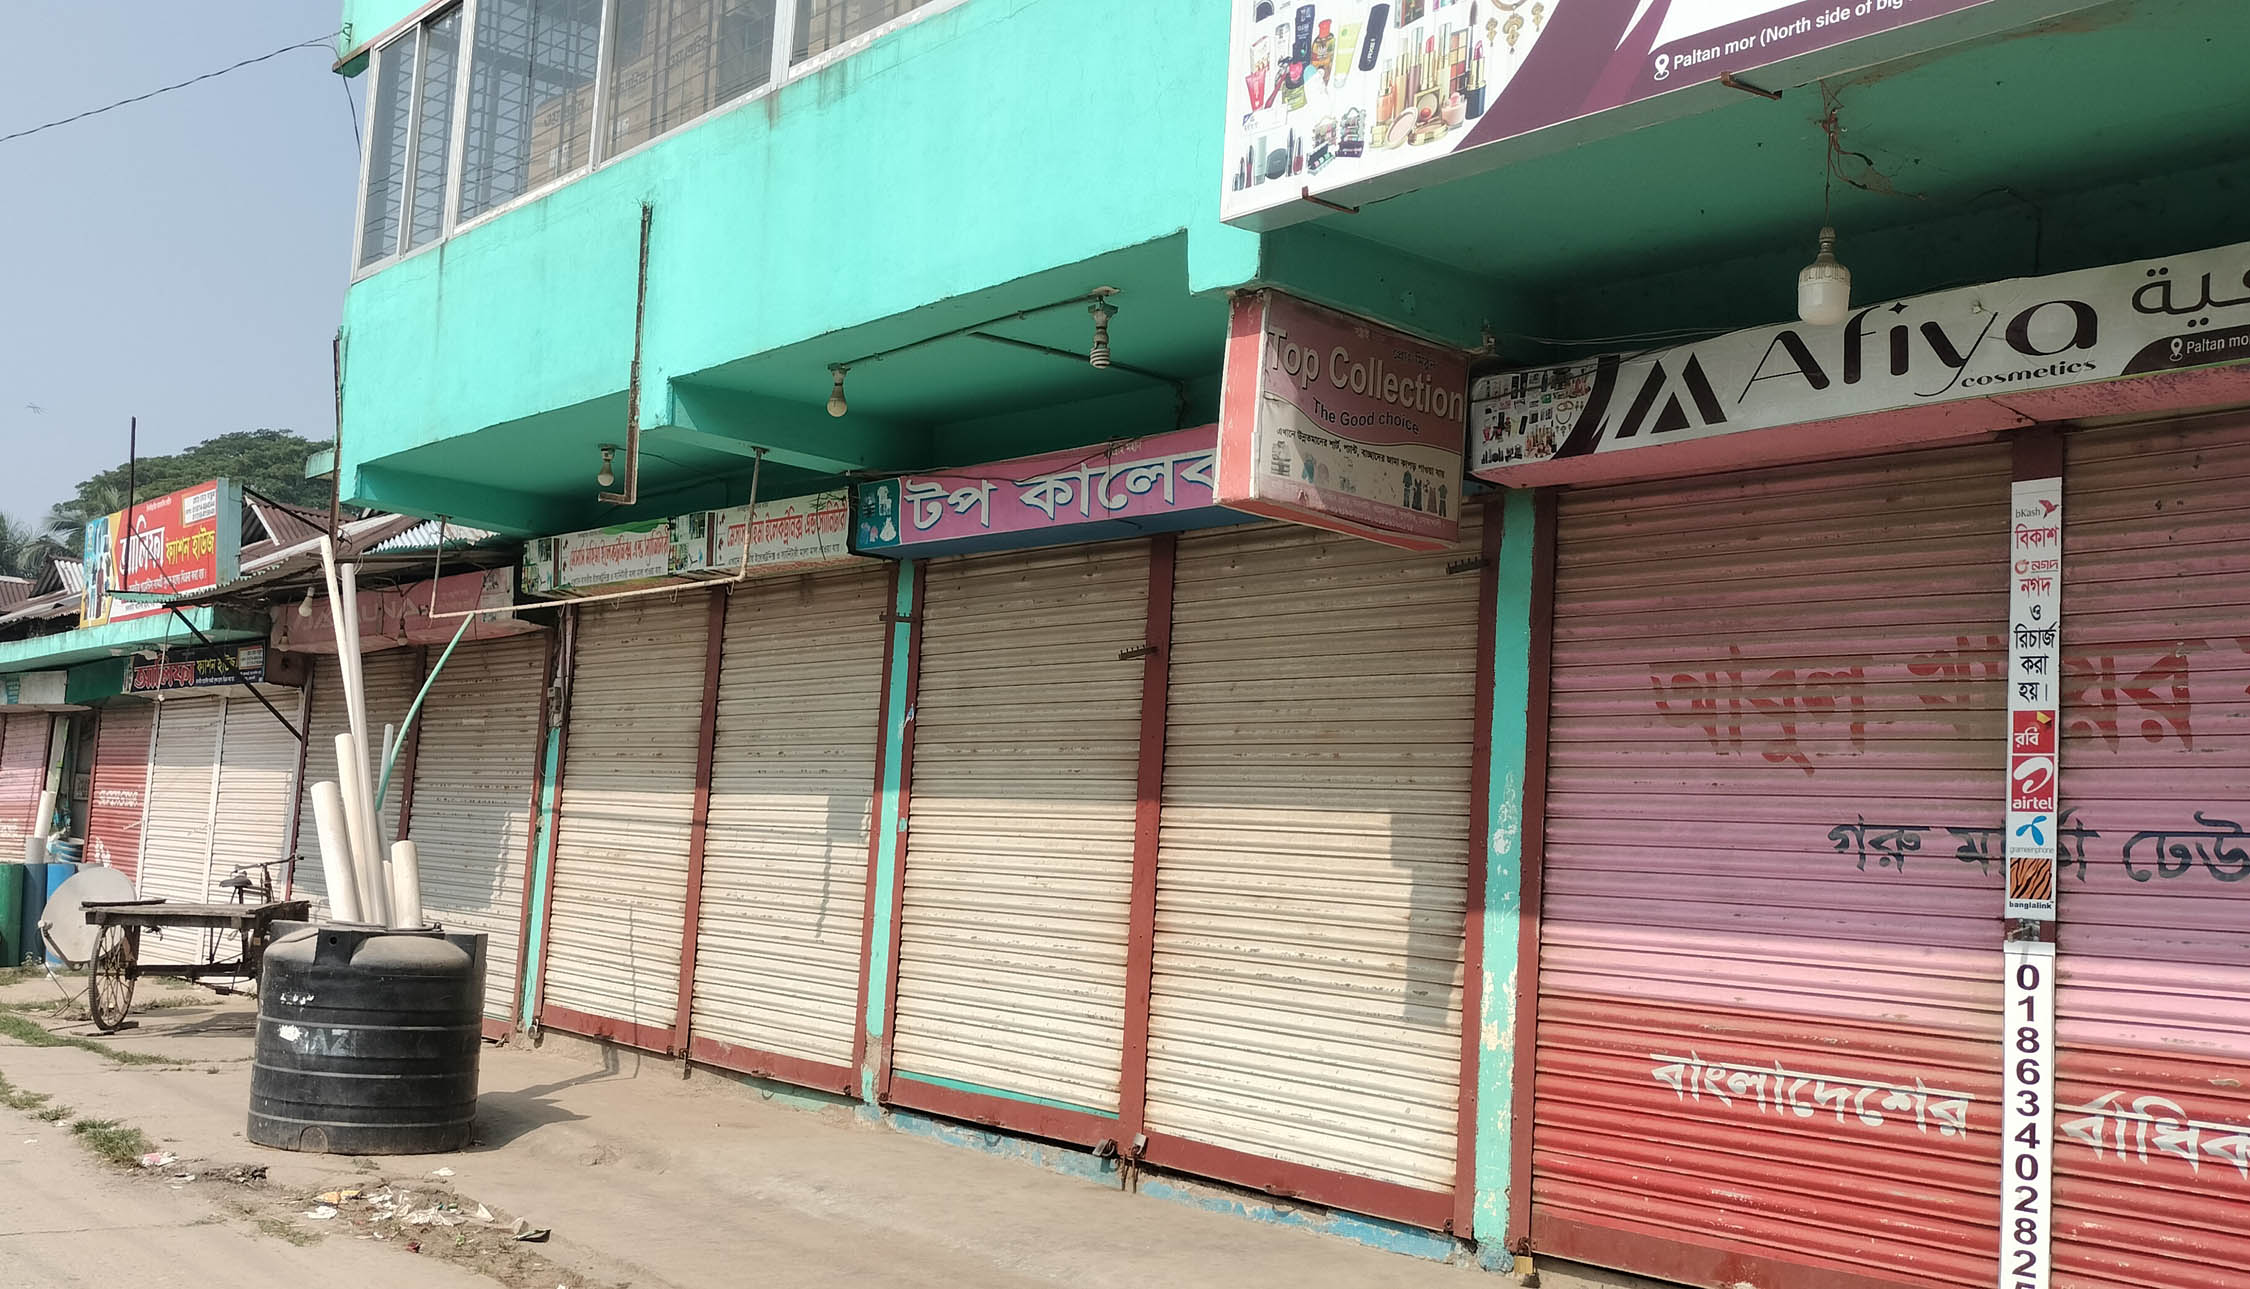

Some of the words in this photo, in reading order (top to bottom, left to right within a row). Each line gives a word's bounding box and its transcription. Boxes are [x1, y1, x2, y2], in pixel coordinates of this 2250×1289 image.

[1673, 44, 1721, 70] Paltan
[1724, 35, 1756, 56] mor
[1759, 15, 1811, 49] (North
[1816, 6, 1851, 28] side
[1855, 0, 1872, 16] of
[2132, 267, 2250, 328] ية
[1738, 298, 2098, 404] Afiya
[2186, 338, 2225, 354] Paltan
[1268, 325, 1321, 391] Top
[1329, 346, 1464, 423] Collection
[1961, 358, 2097, 388] cosmetics
[1312, 397, 1336, 424] The
[1340, 410, 1375, 428] Good
[1379, 411, 1420, 436] choice
[904, 478, 997, 531] টপ
[2015, 507, 2041, 519] bKash
[2015, 523, 2059, 551] বিকাশ
[2020, 577, 2053, 598] নগদ
[2029, 604, 2042, 621] ও
[2013, 621, 2057, 650] রিচার্জ
[2020, 654, 2049, 676] করা
[2015, 726, 2039, 748] রবি
[2013, 797, 2053, 811] airtel
[1827, 813, 1931, 874] গরু
[2009, 900, 2053, 910] banglalink
[1650, 1049, 1976, 1142] বাংলাদেশের
[2007, 964, 2040, 1289] 0186340282
